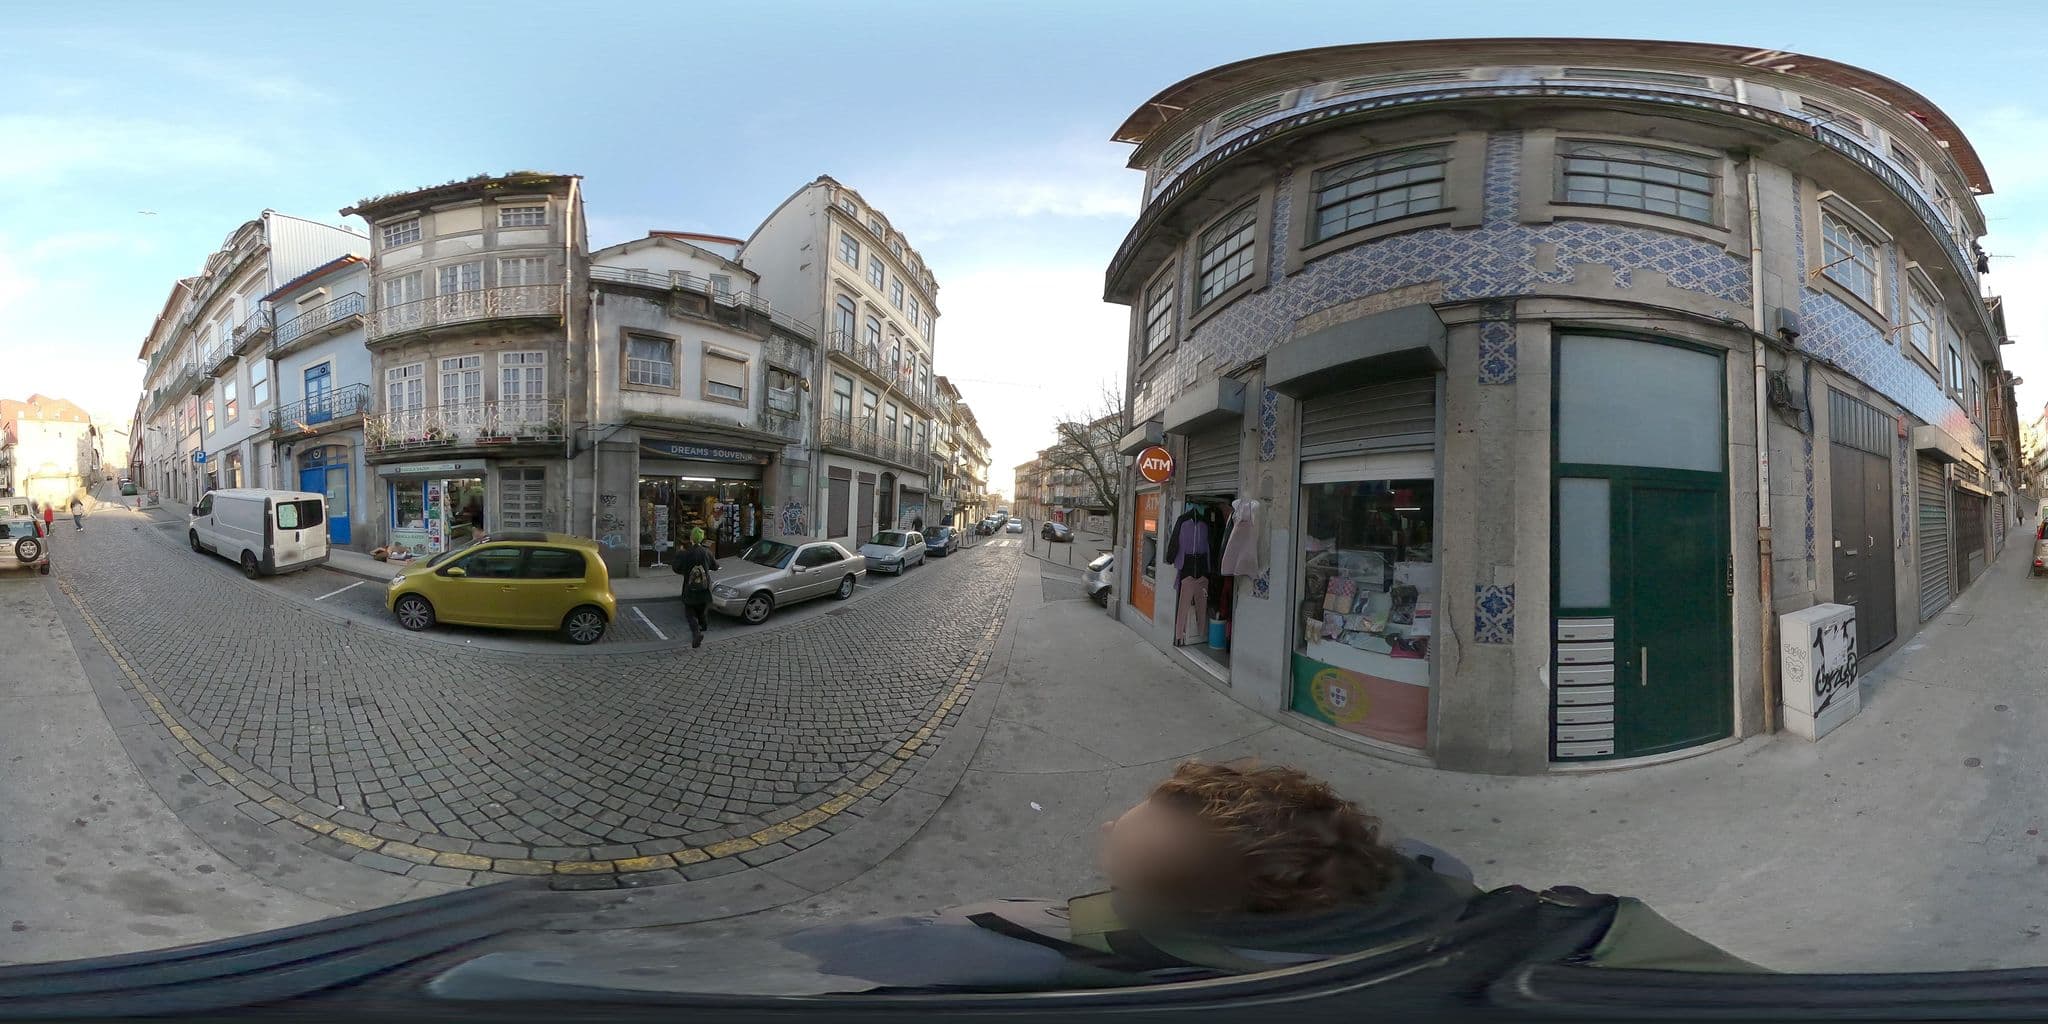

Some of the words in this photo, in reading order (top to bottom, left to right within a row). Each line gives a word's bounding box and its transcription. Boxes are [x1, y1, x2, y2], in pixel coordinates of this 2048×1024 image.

[197, 452, 205, 462] P
[671, 445, 709, 456] DREAMS
[713, 449, 753, 461] SOUVENIR
[1142, 457, 1171, 472] ATM
